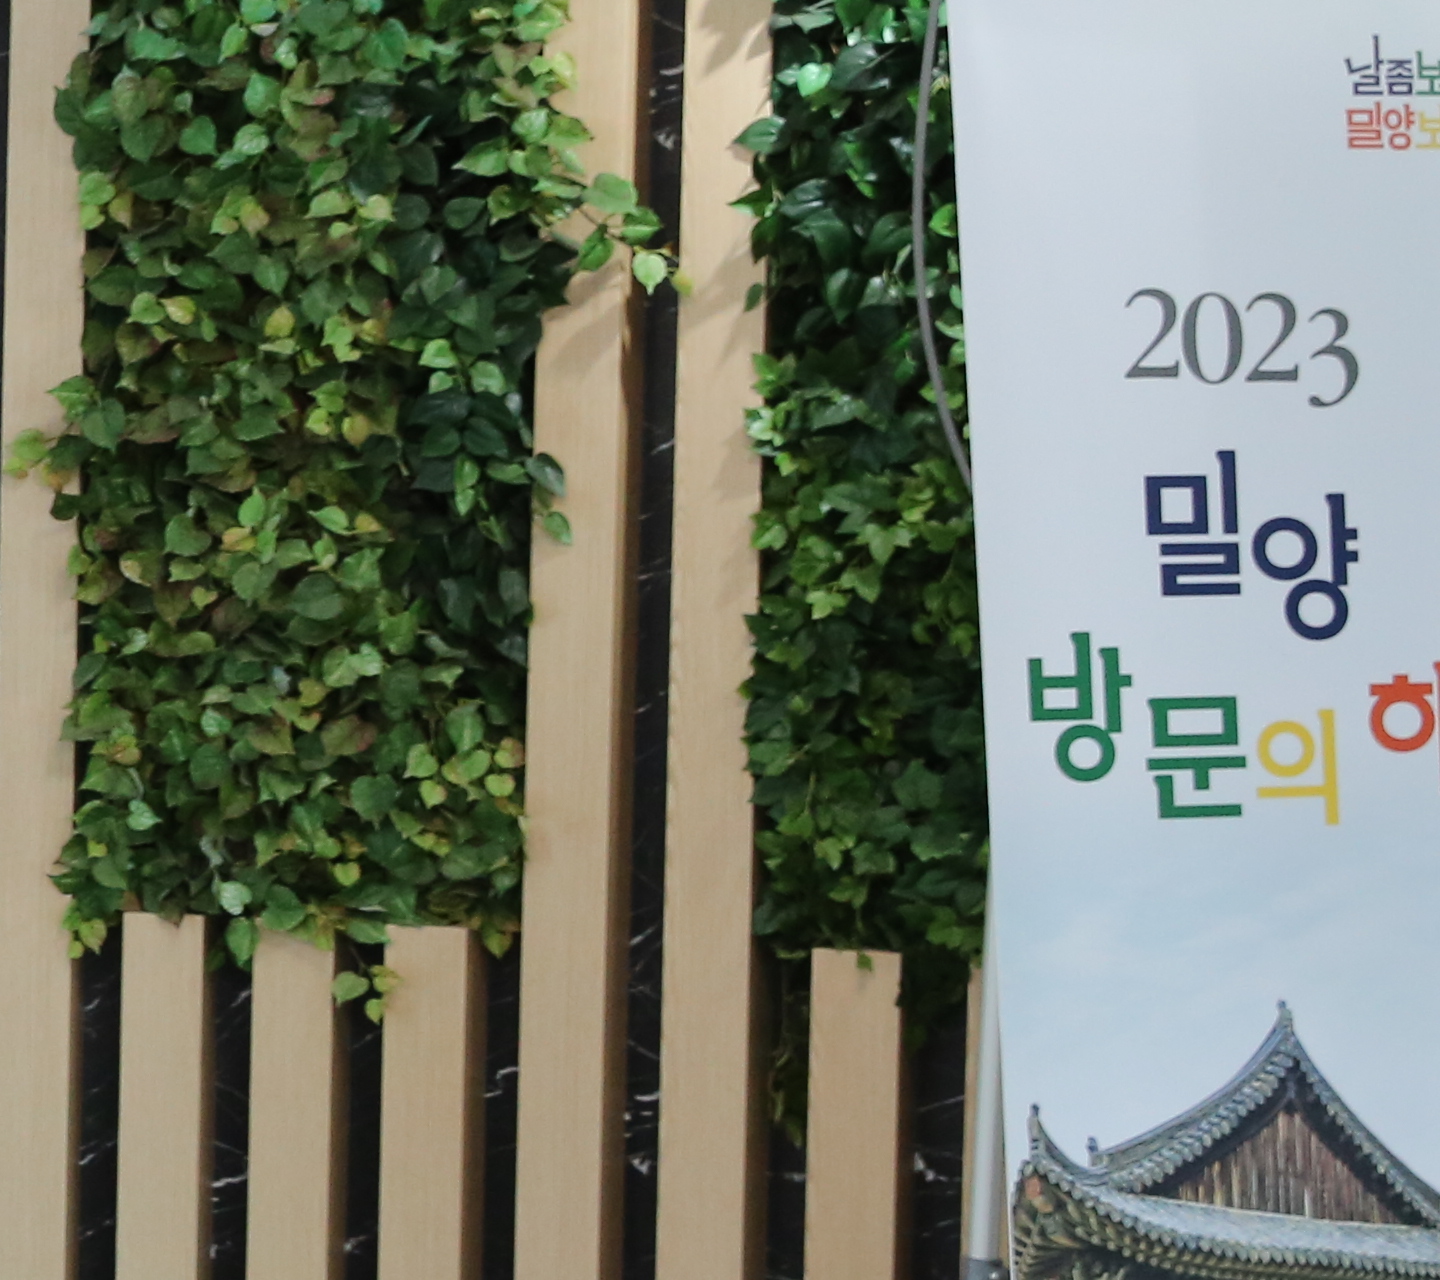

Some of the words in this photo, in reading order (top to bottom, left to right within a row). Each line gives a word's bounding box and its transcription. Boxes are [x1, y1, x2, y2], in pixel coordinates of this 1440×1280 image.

[1123, 288, 1360, 408] 2023
[1143, 449, 1360, 641] 밀양
[1027, 631, 1340, 826] 방문의
